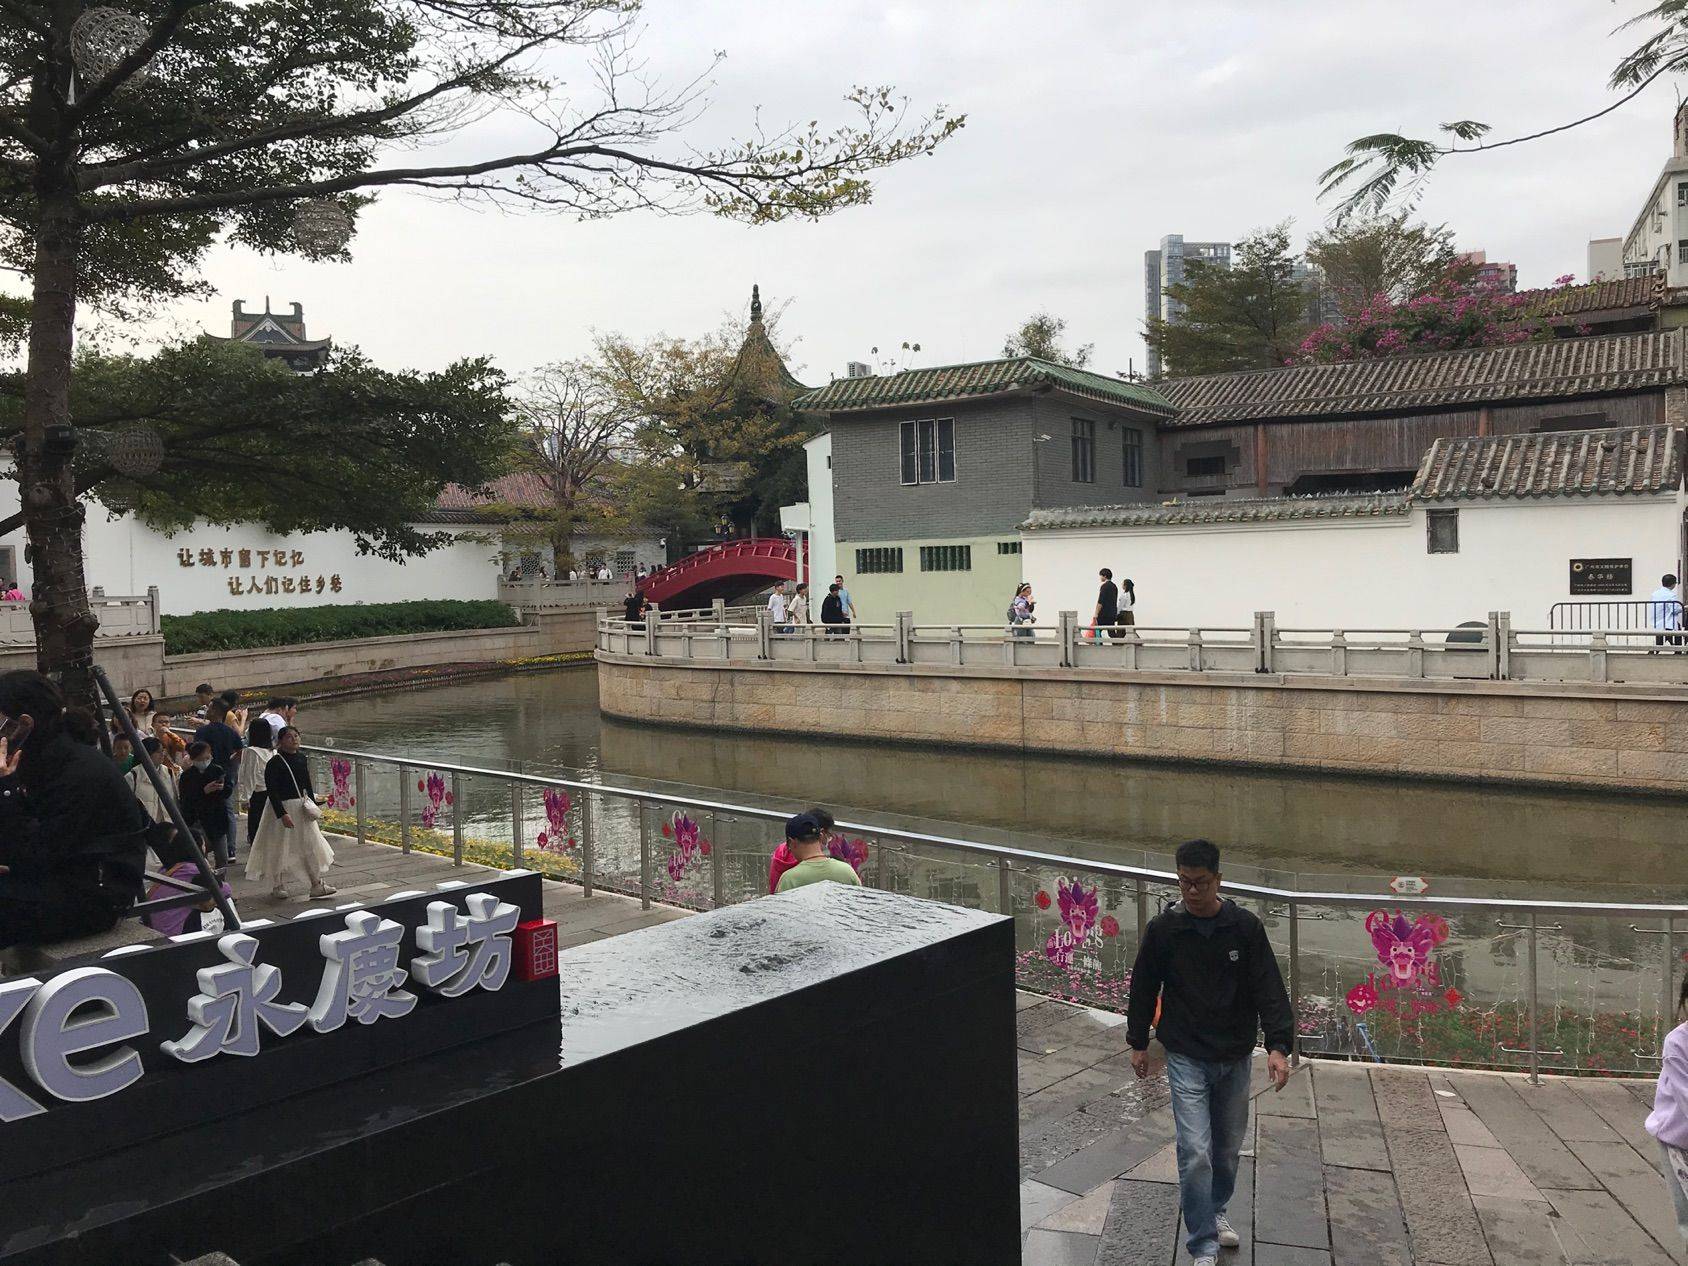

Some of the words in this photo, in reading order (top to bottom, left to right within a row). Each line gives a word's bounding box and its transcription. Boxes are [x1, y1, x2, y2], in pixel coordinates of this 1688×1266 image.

[177, 547, 305, 569] 让城市留下记忆
[227, 573, 343, 596] 让人们记住乡愁
